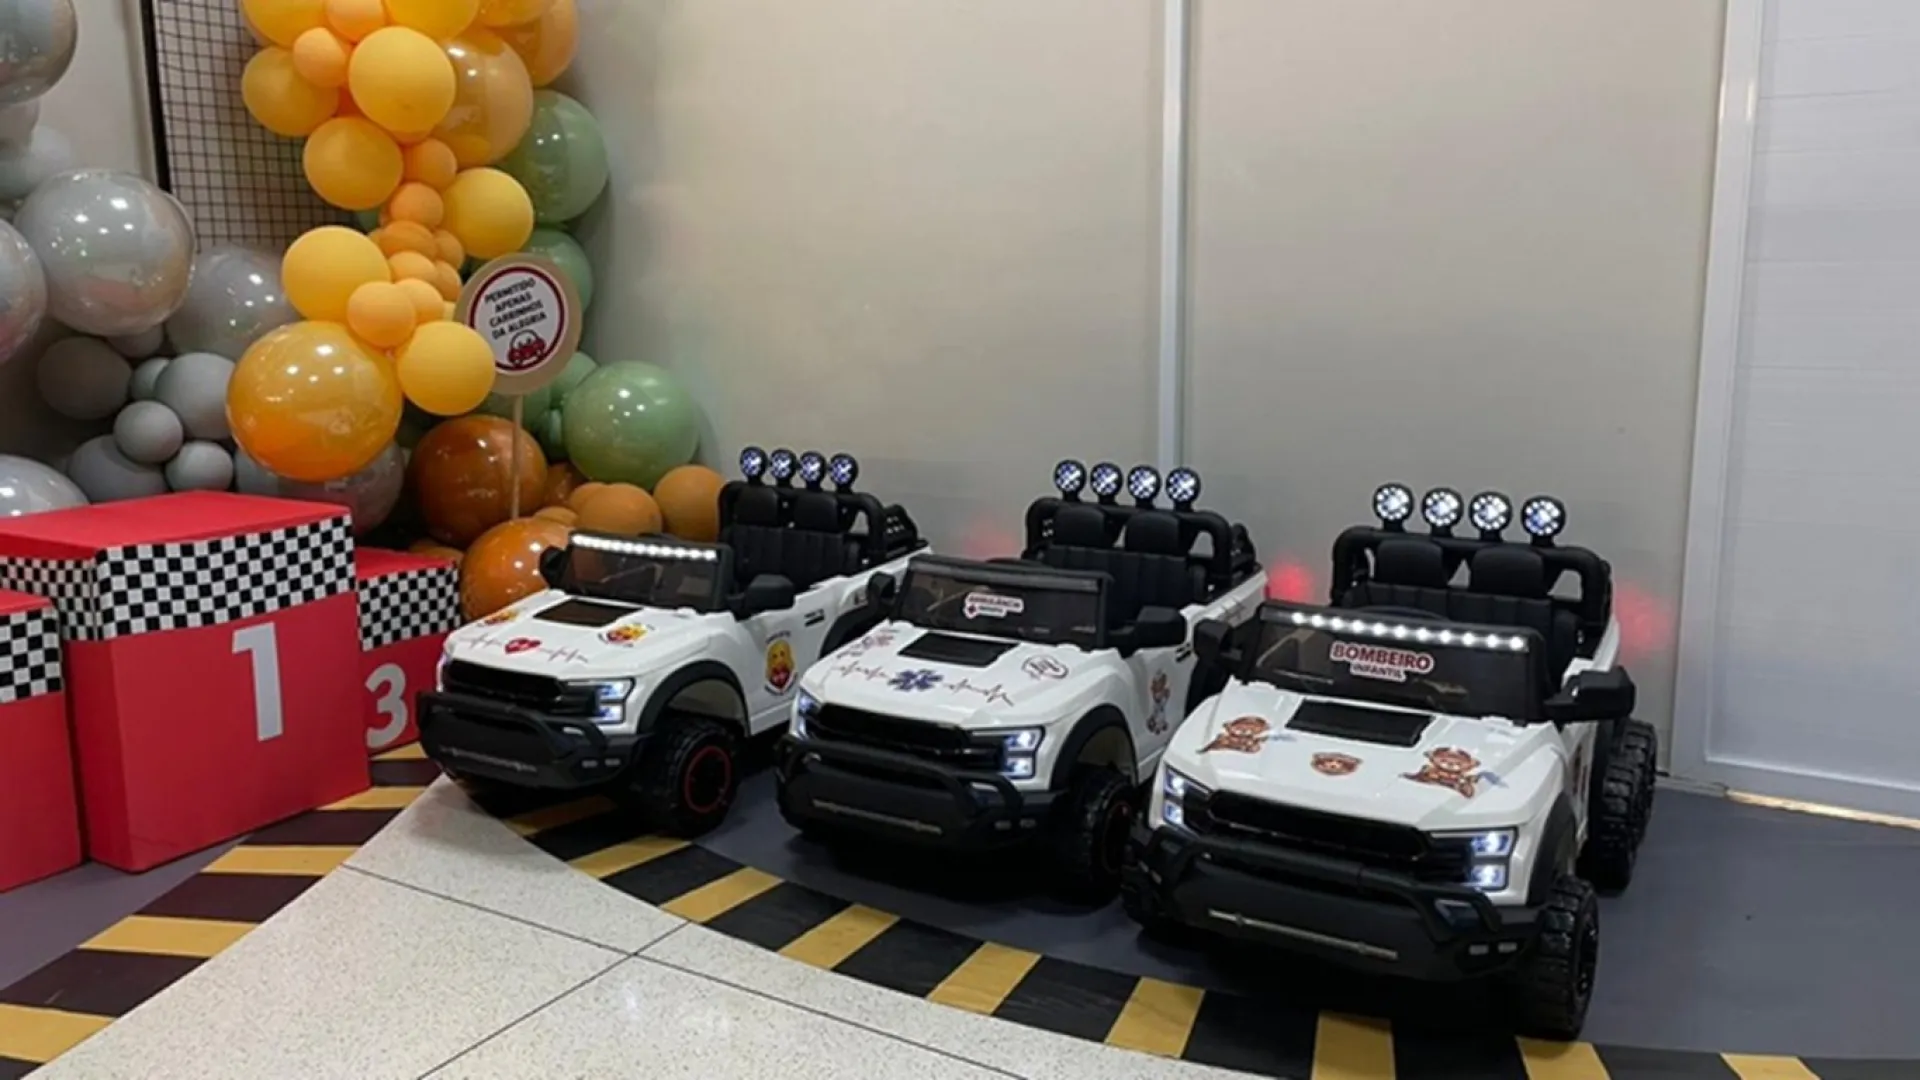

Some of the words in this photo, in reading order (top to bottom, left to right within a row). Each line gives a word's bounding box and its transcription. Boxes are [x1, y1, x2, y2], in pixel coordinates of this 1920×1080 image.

[485, 277, 536, 303] PERMITIDO
[495, 291, 532, 312] APENAS
[492, 328, 506, 339] DA
[508, 311, 547, 332] ALEGRIA
[1333, 643, 1431, 670] BOMBEIRO
[232, 621, 283, 741] 1
[1352, 663, 1403, 678] INFANTIL
[365, 663, 408, 748] 3
